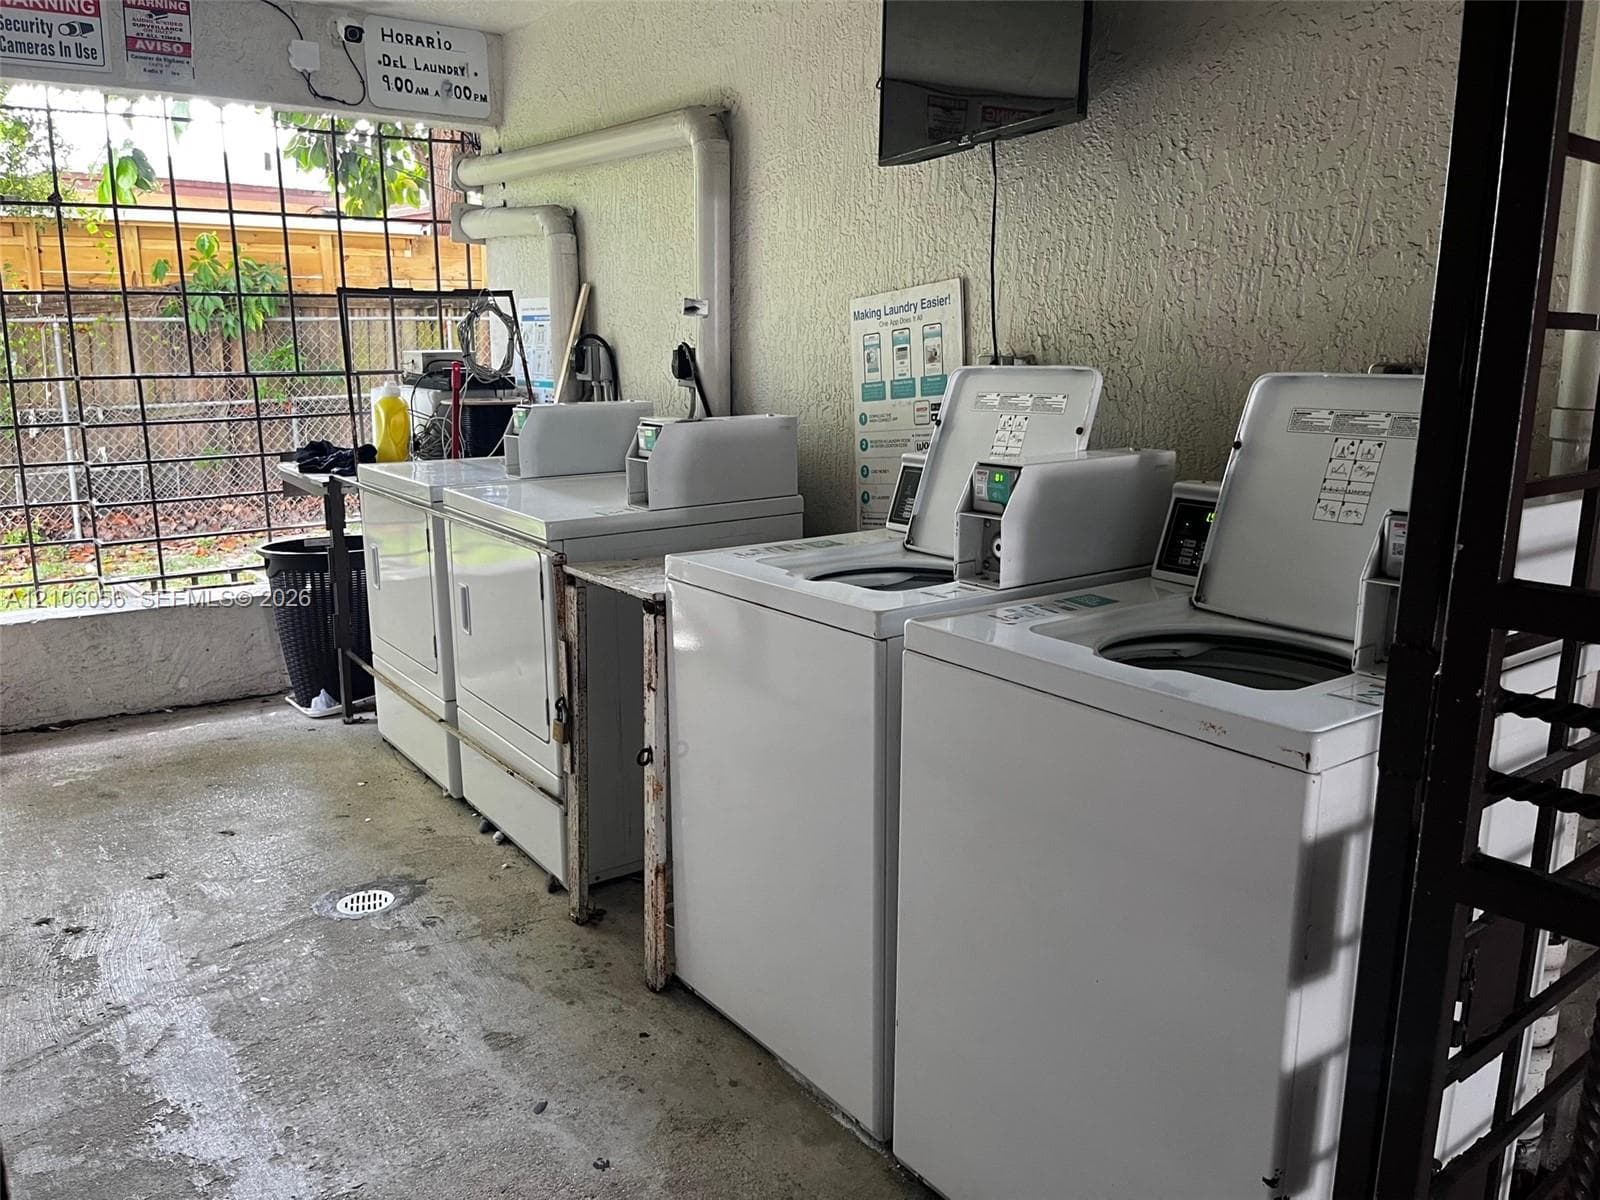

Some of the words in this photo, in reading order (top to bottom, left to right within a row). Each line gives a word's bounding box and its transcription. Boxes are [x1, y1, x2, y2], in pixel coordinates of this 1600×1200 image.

[0, 14, 53, 38] Security
[0, 35, 55, 57] Cameras
[59, 40, 72, 58] In
[75, 42, 98, 60] Use
[135, 39, 184, 54] AVISO
[853, 308, 882, 322] Making
[884, 301, 918, 316] Laundry
[921, 293, 952, 310] Easier!
